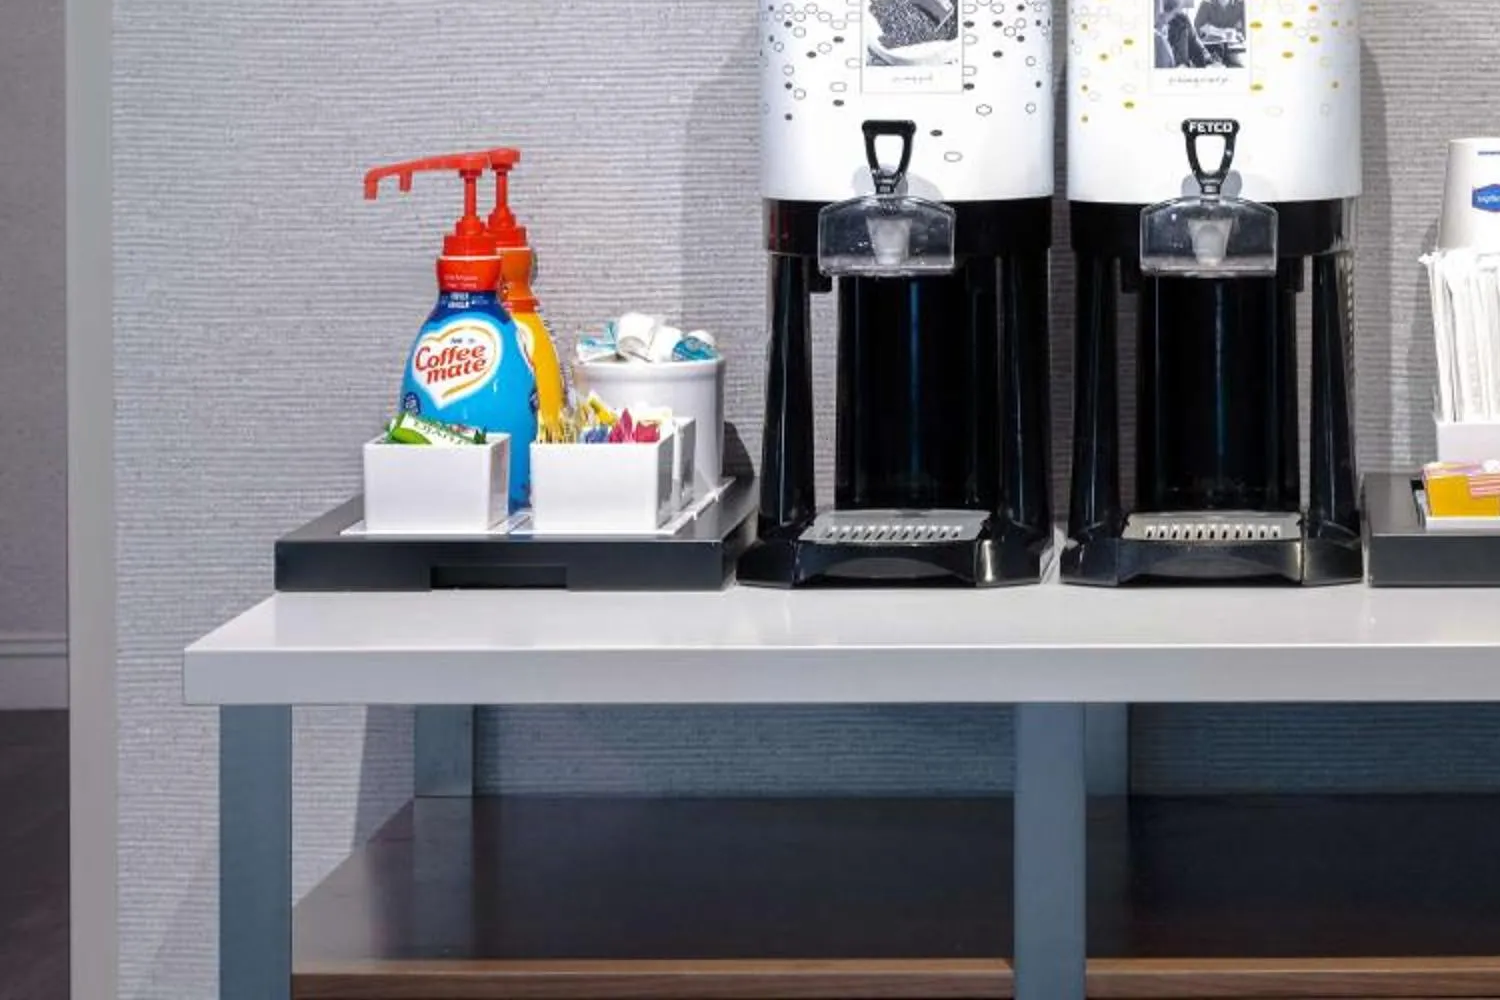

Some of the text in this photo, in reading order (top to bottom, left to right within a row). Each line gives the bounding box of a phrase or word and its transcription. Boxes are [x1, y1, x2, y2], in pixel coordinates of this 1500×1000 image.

[1188, 122, 1233, 133] FETCO
[415, 344, 486, 371] Coffee
[426, 358, 487, 384] mate
